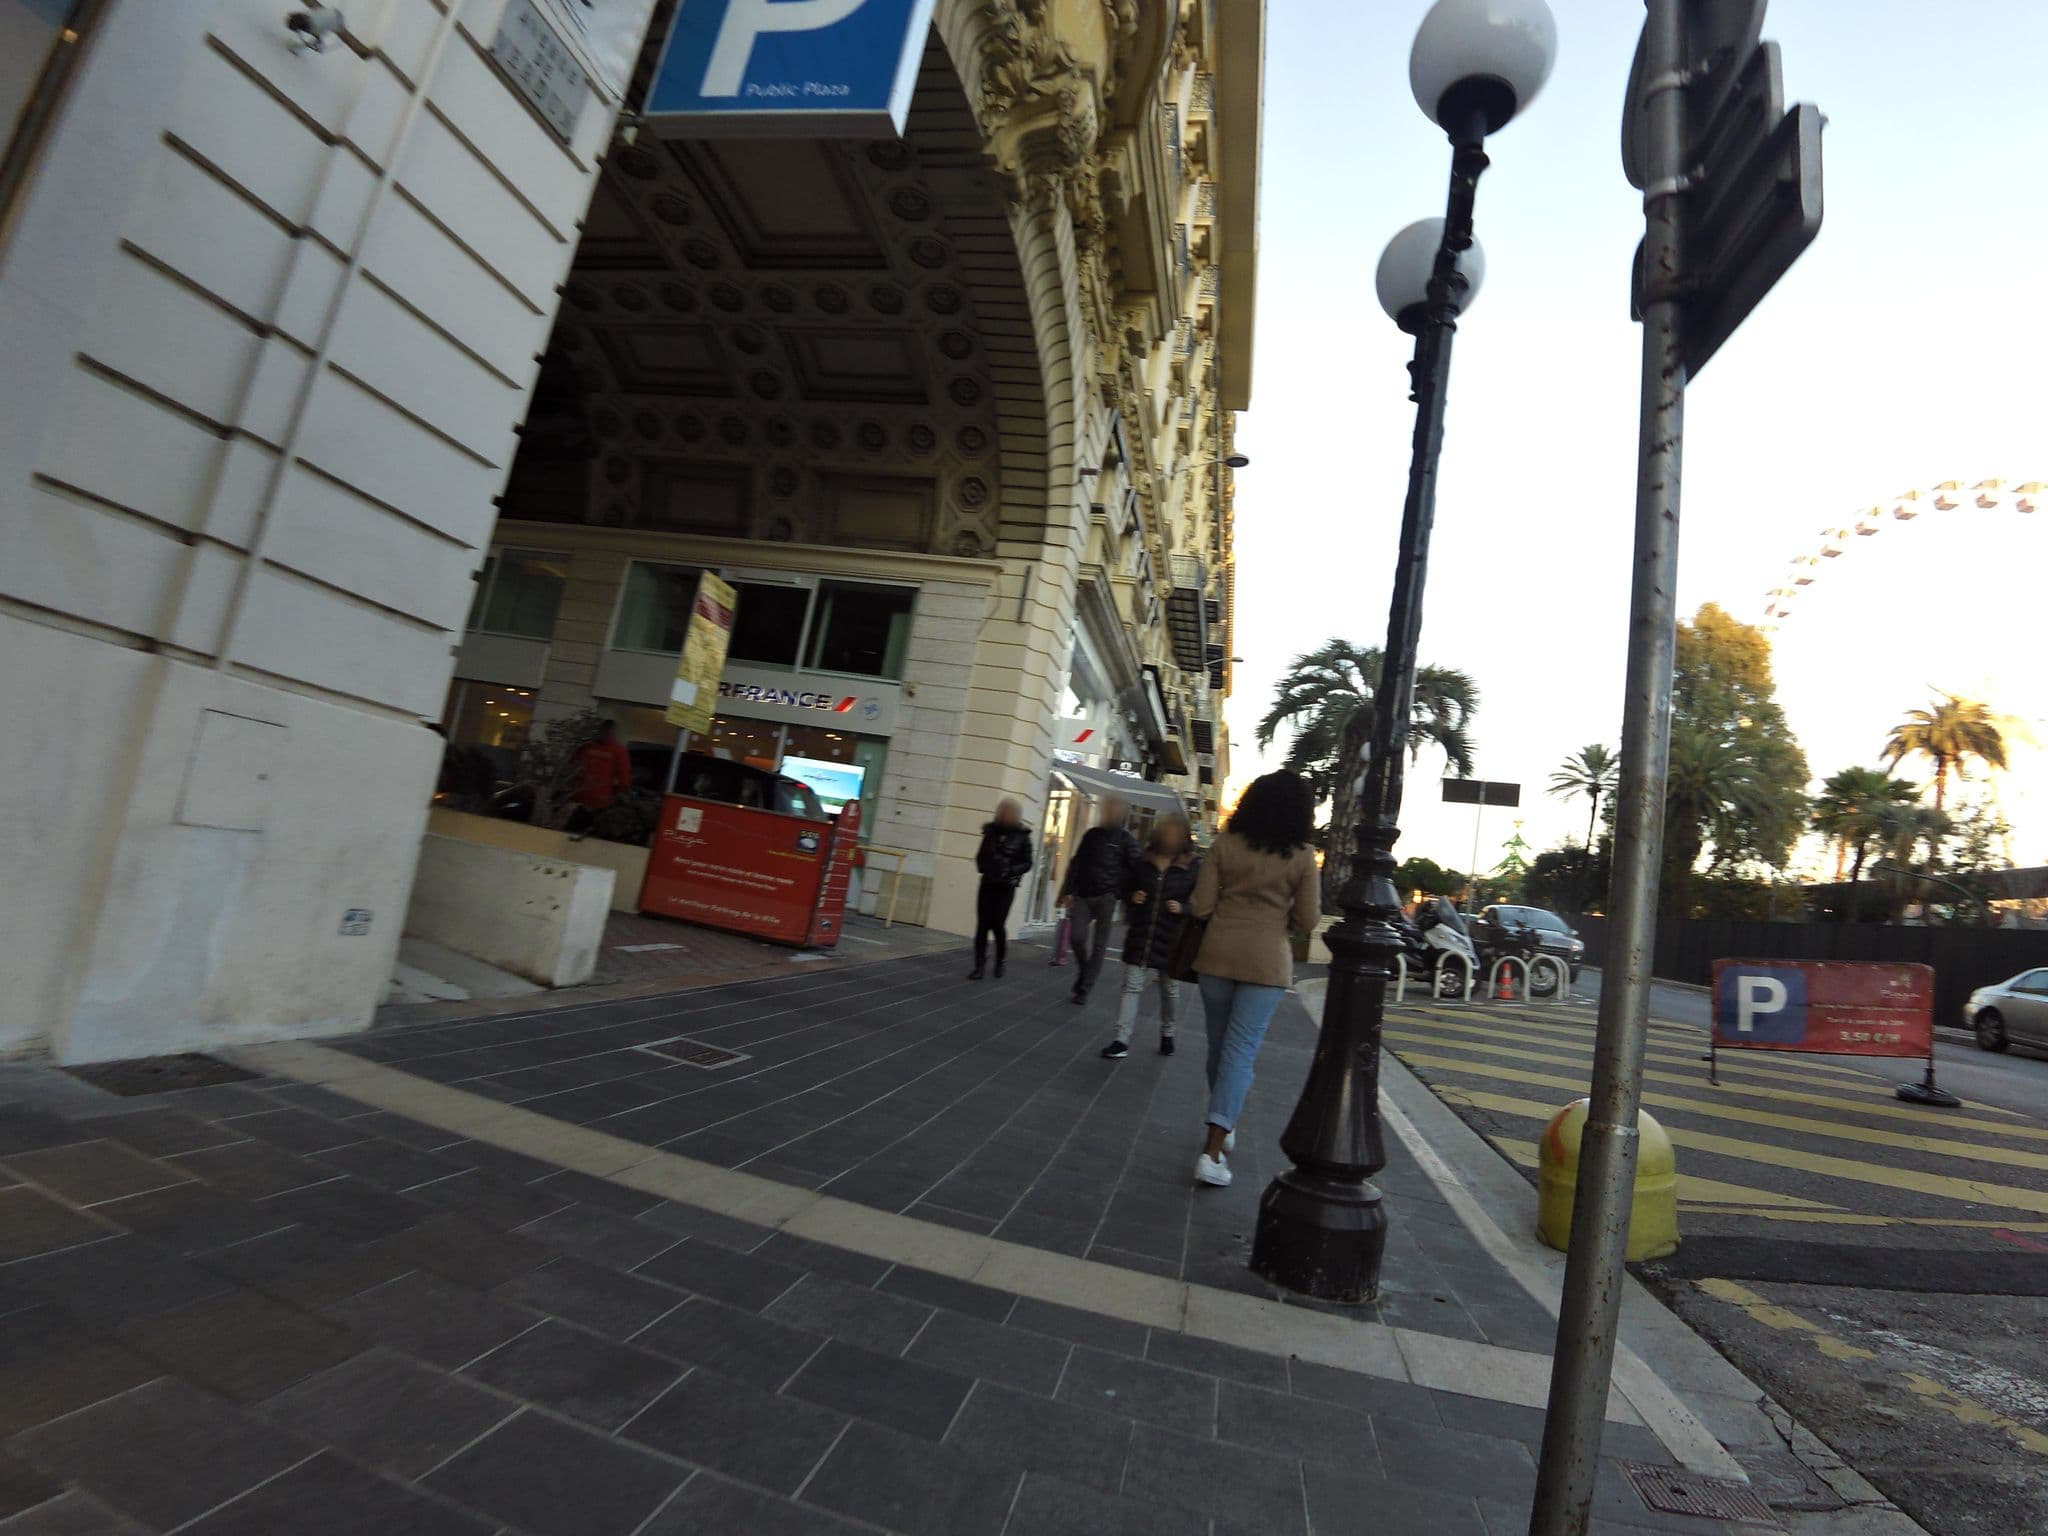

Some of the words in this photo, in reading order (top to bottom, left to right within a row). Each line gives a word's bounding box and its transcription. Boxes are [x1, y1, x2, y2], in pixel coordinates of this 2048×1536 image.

[747, 82, 799, 97] Public
[803, 81, 850, 96] Plaza
[718, 681, 833, 711] RFRANCE
[1737, 975, 1788, 1032] P
